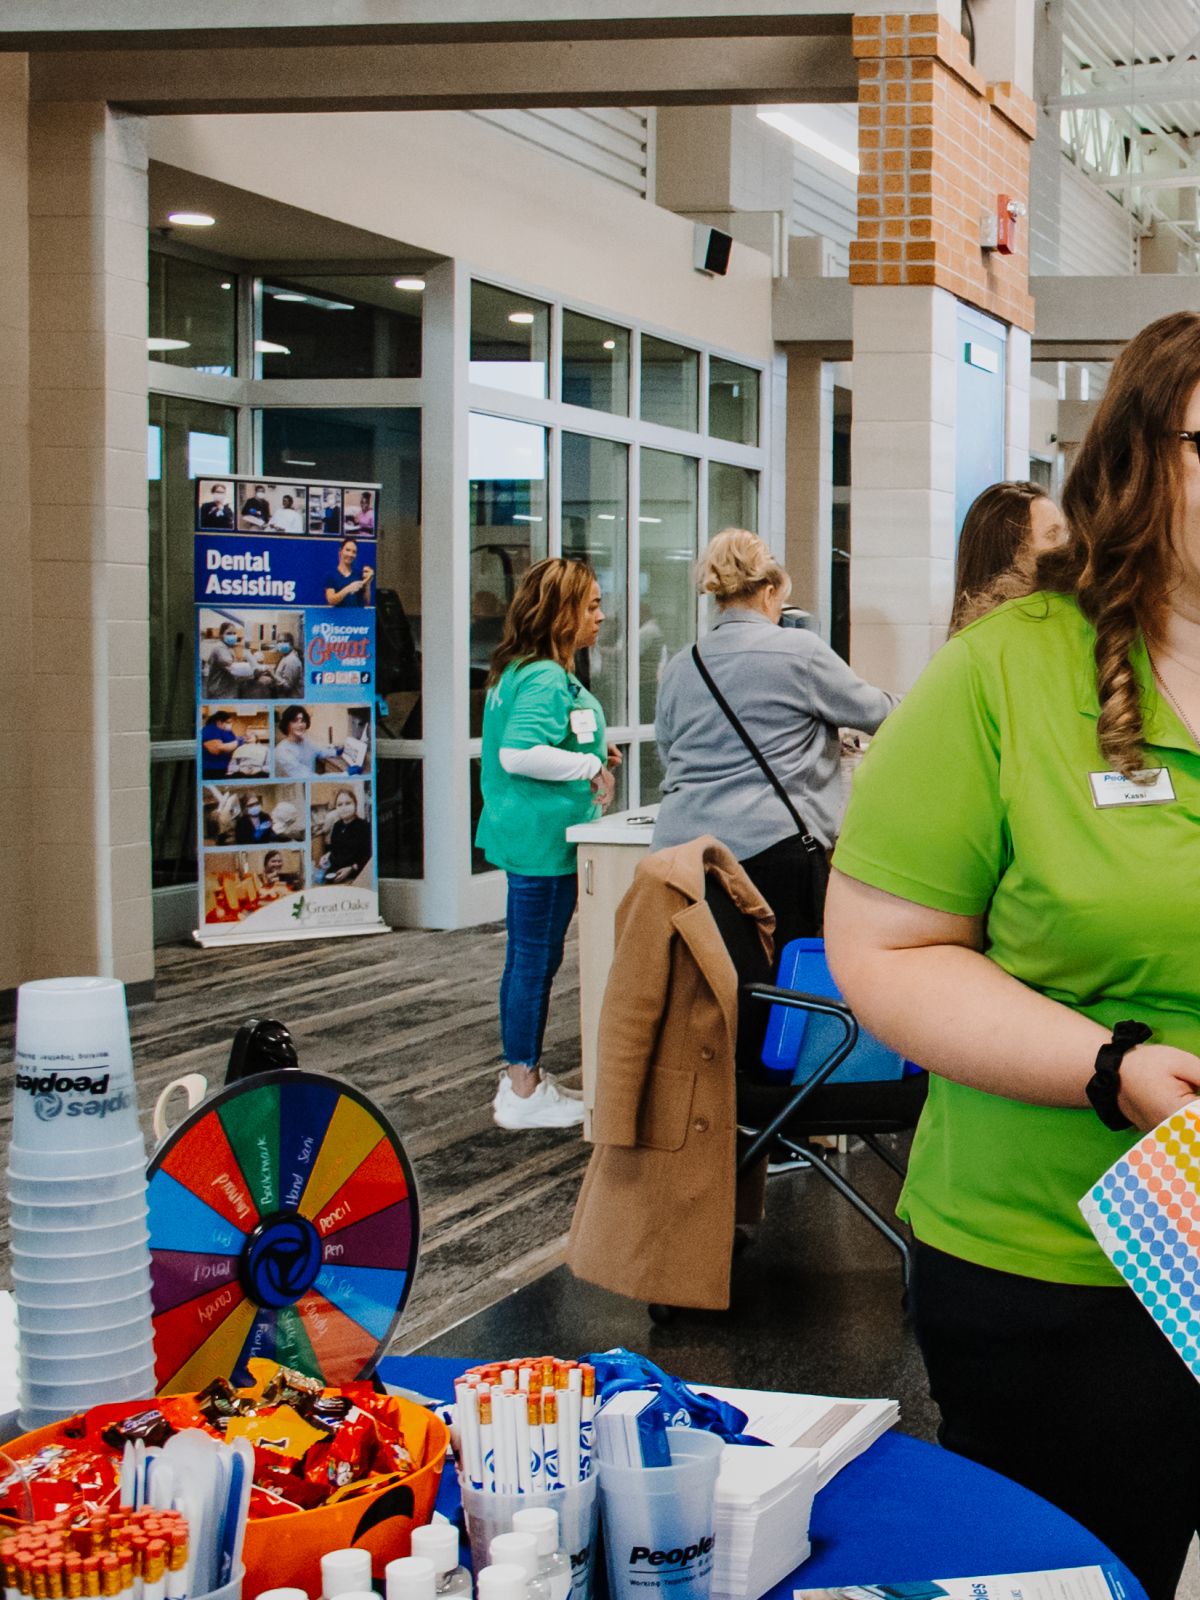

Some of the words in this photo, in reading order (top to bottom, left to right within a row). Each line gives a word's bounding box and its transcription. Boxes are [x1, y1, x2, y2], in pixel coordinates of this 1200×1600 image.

[206, 549, 271, 573] Dental
[205, 573, 296, 602] Assisting
[311, 622, 370, 635] #Discover
[306, 901, 338, 914] Great
[340, 899, 369, 911] Oaks
[629, 1579, 661, 1588] Working
